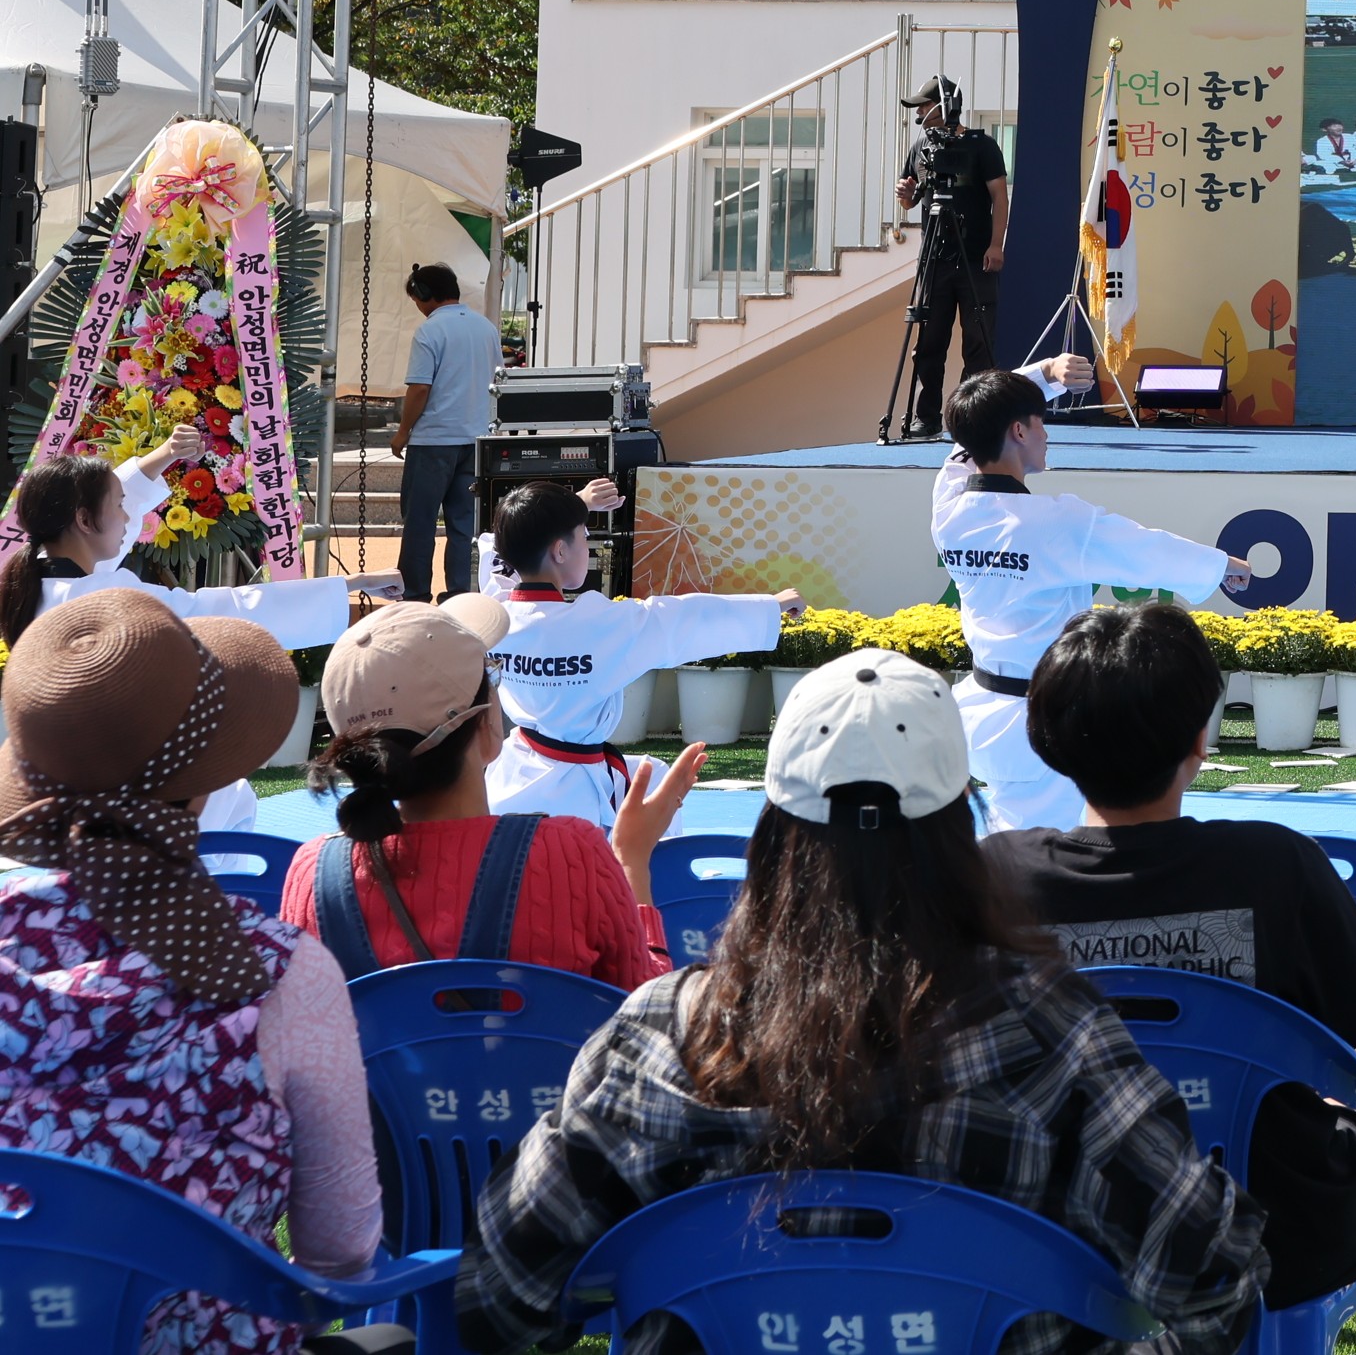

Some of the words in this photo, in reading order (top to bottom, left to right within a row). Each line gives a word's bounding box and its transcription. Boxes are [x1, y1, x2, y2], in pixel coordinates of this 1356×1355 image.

[1198, 71, 1270, 110] 좋다
[538, 148, 566, 156] SHURE
[1088, 121, 1187, 157] 람이
[1196, 122, 1268, 161] 좋다
[1129, 172, 1186, 208] 성이
[1195, 173, 1266, 212] 좋다
[107, 231, 141, 286] 재경
[235, 252, 268, 275] 祝
[54, 290, 121, 427] 안성면민회
[238, 285, 275, 411] 안성면민의
[251, 415, 281, 441] 날
[965, 550, 1029, 572] SUCCESS
[513, 654, 593, 677] SUCCESS
[1070, 928, 1206, 962] NATIONAL
[757, 1311, 938, 1355] 안성면
